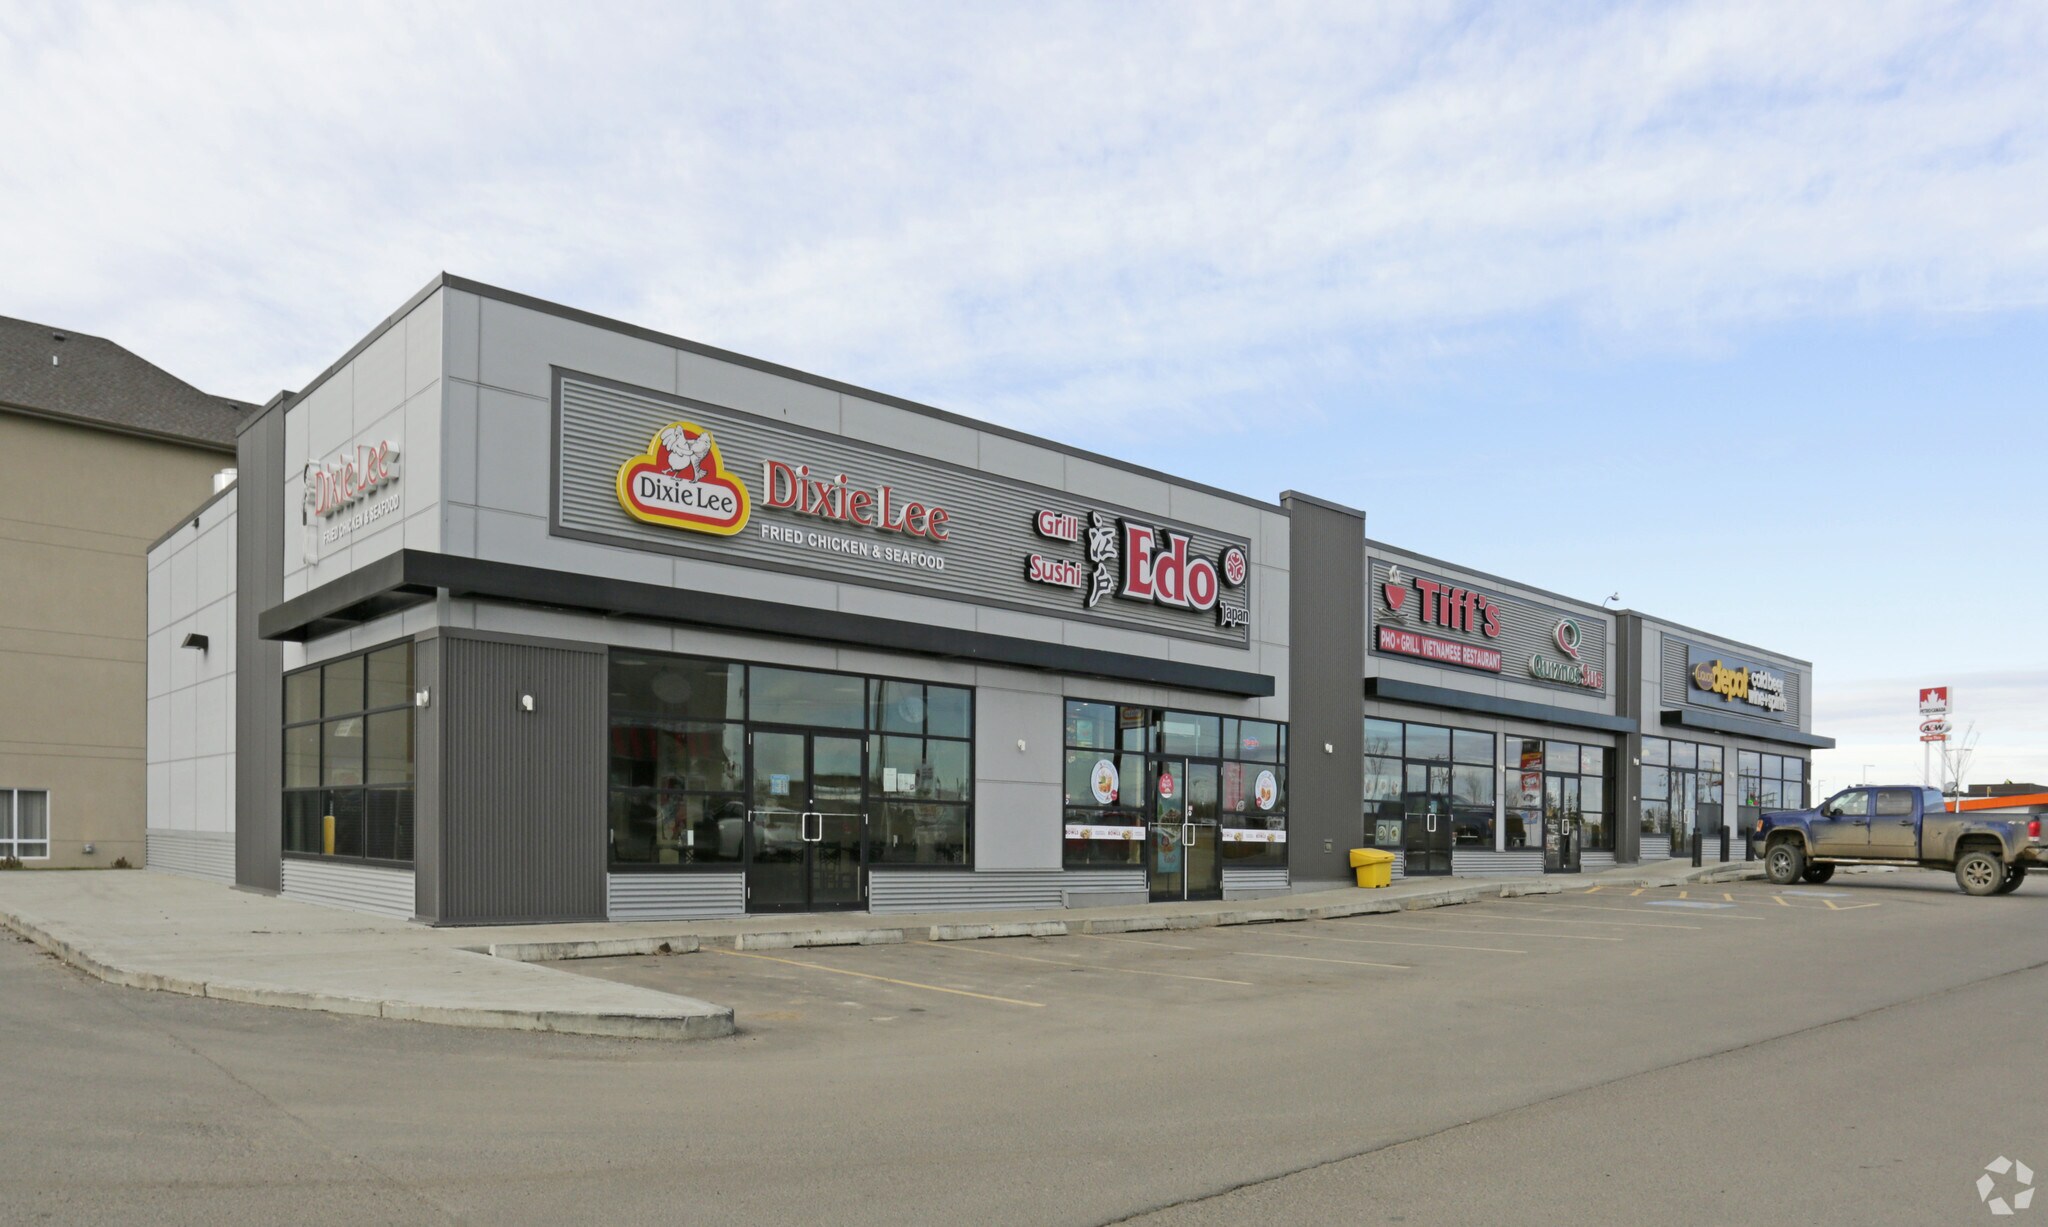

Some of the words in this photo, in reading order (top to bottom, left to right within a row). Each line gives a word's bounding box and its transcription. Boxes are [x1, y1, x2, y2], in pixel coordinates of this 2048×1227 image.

[315, 453, 354, 516] Dixie
[356, 440, 388, 491] Lee
[640, 475, 693, 504] Dixie
[696, 485, 734, 514] Lee
[323, 526, 340, 545] FRIED
[340, 513, 365, 537] CHICKEN
[369, 494, 400, 522] SEAFOOD
[760, 458, 874, 526] Dixie
[876, 485, 950, 541] Lee
[1038, 508, 1078, 542] Grill
[760, 524, 804, 545] FRIED
[807, 532, 868, 557] CHICKEN
[871, 544, 882, 558] &
[884, 546, 945, 571] SEAFOOD
[1122, 521, 1219, 611] Edo
[1029, 553, 1082, 588] Sushi
[1219, 601, 1250, 627] Japan
[1415, 577, 1500, 638] Tiff's
[1380, 629, 1396, 649] PHO
[1400, 634, 1420, 654] GRILL
[1421, 638, 1461, 662] VIETNAMESE
[1462, 646, 1501, 669] RESTAURANT
[1712, 659, 1749, 702] depot
[1751, 670, 1768, 689] cold
[1923, 724, 1945, 732] A&W
